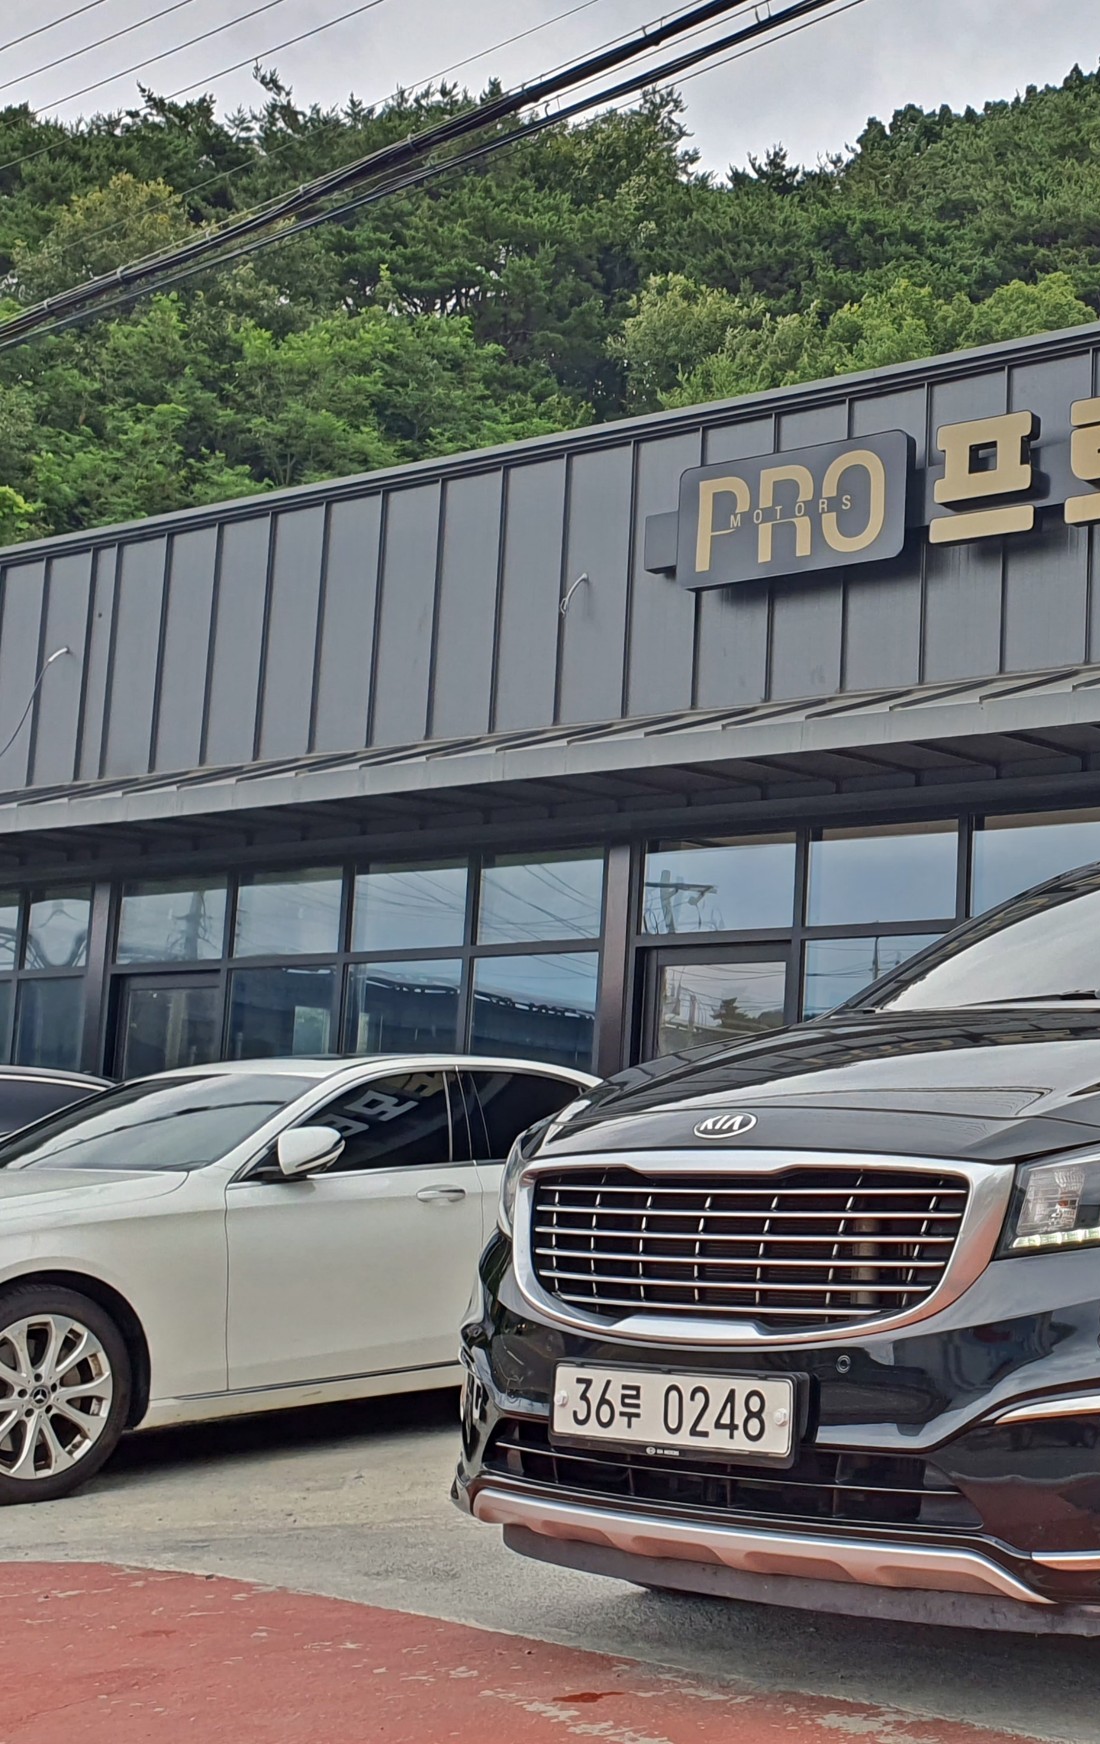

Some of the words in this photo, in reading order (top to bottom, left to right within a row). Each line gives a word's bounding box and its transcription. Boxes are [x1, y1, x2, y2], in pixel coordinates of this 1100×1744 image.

[695, 449, 886, 572] PRO
[729, 494, 852, 528] MOTORS
[663, 1384, 766, 1442] 0248
